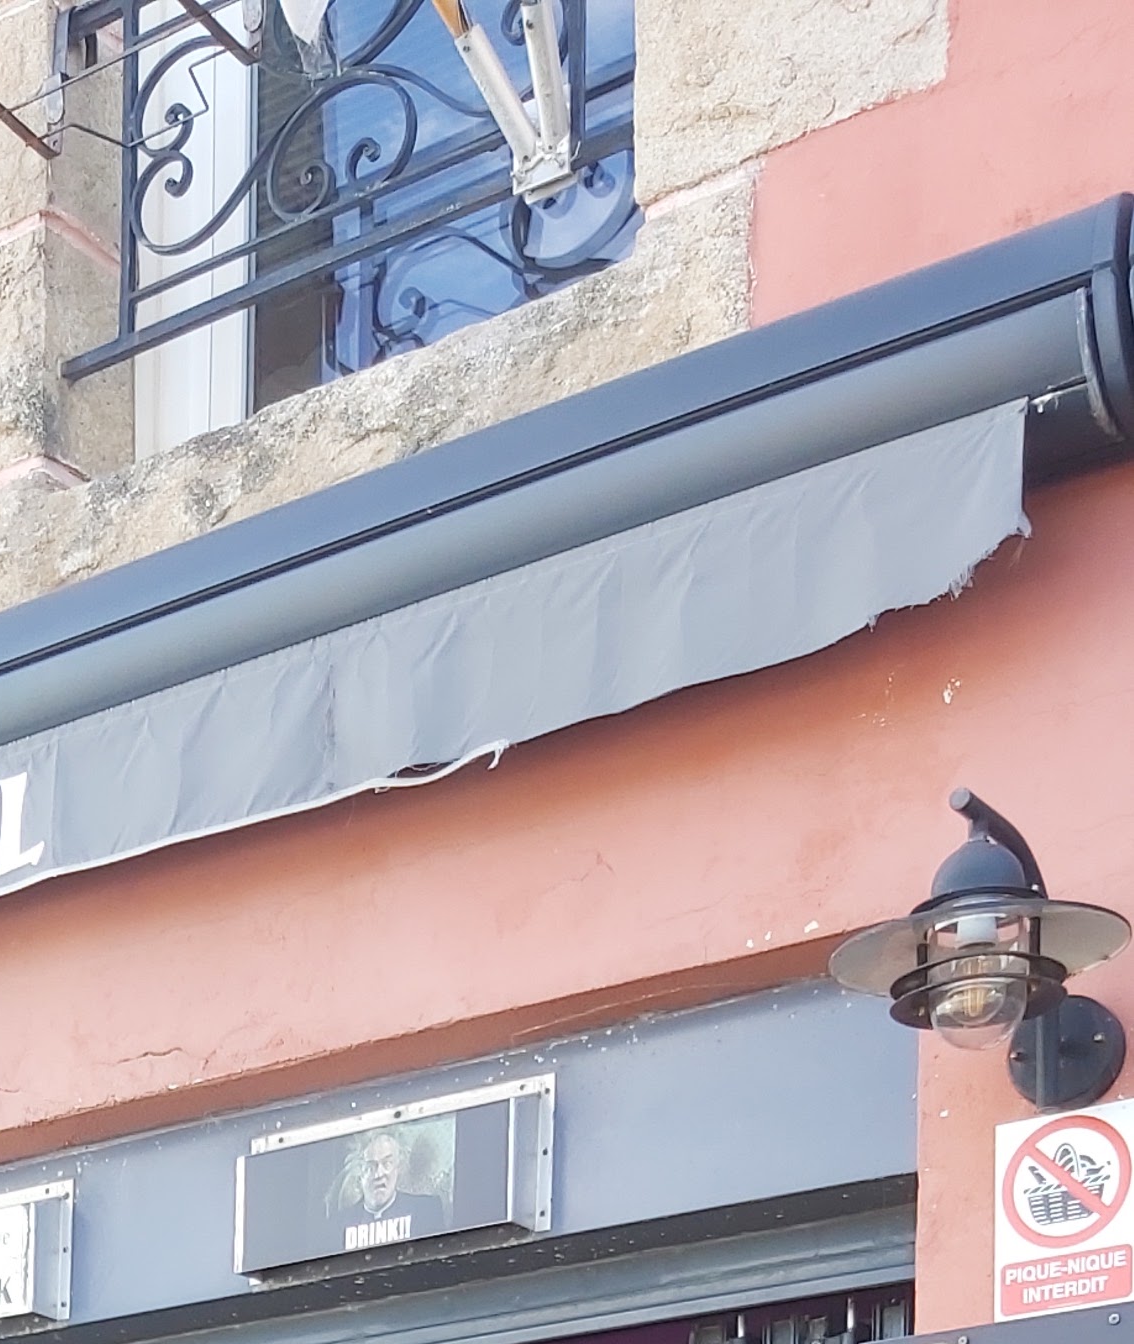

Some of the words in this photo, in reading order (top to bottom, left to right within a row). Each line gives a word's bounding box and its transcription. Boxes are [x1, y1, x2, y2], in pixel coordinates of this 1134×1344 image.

[345, 1215, 412, 1250] DRINK!!
[1004, 1250, 1127, 1286] PIQUE-NIQUE
[1022, 1275, 1109, 1304] INTERDIT
